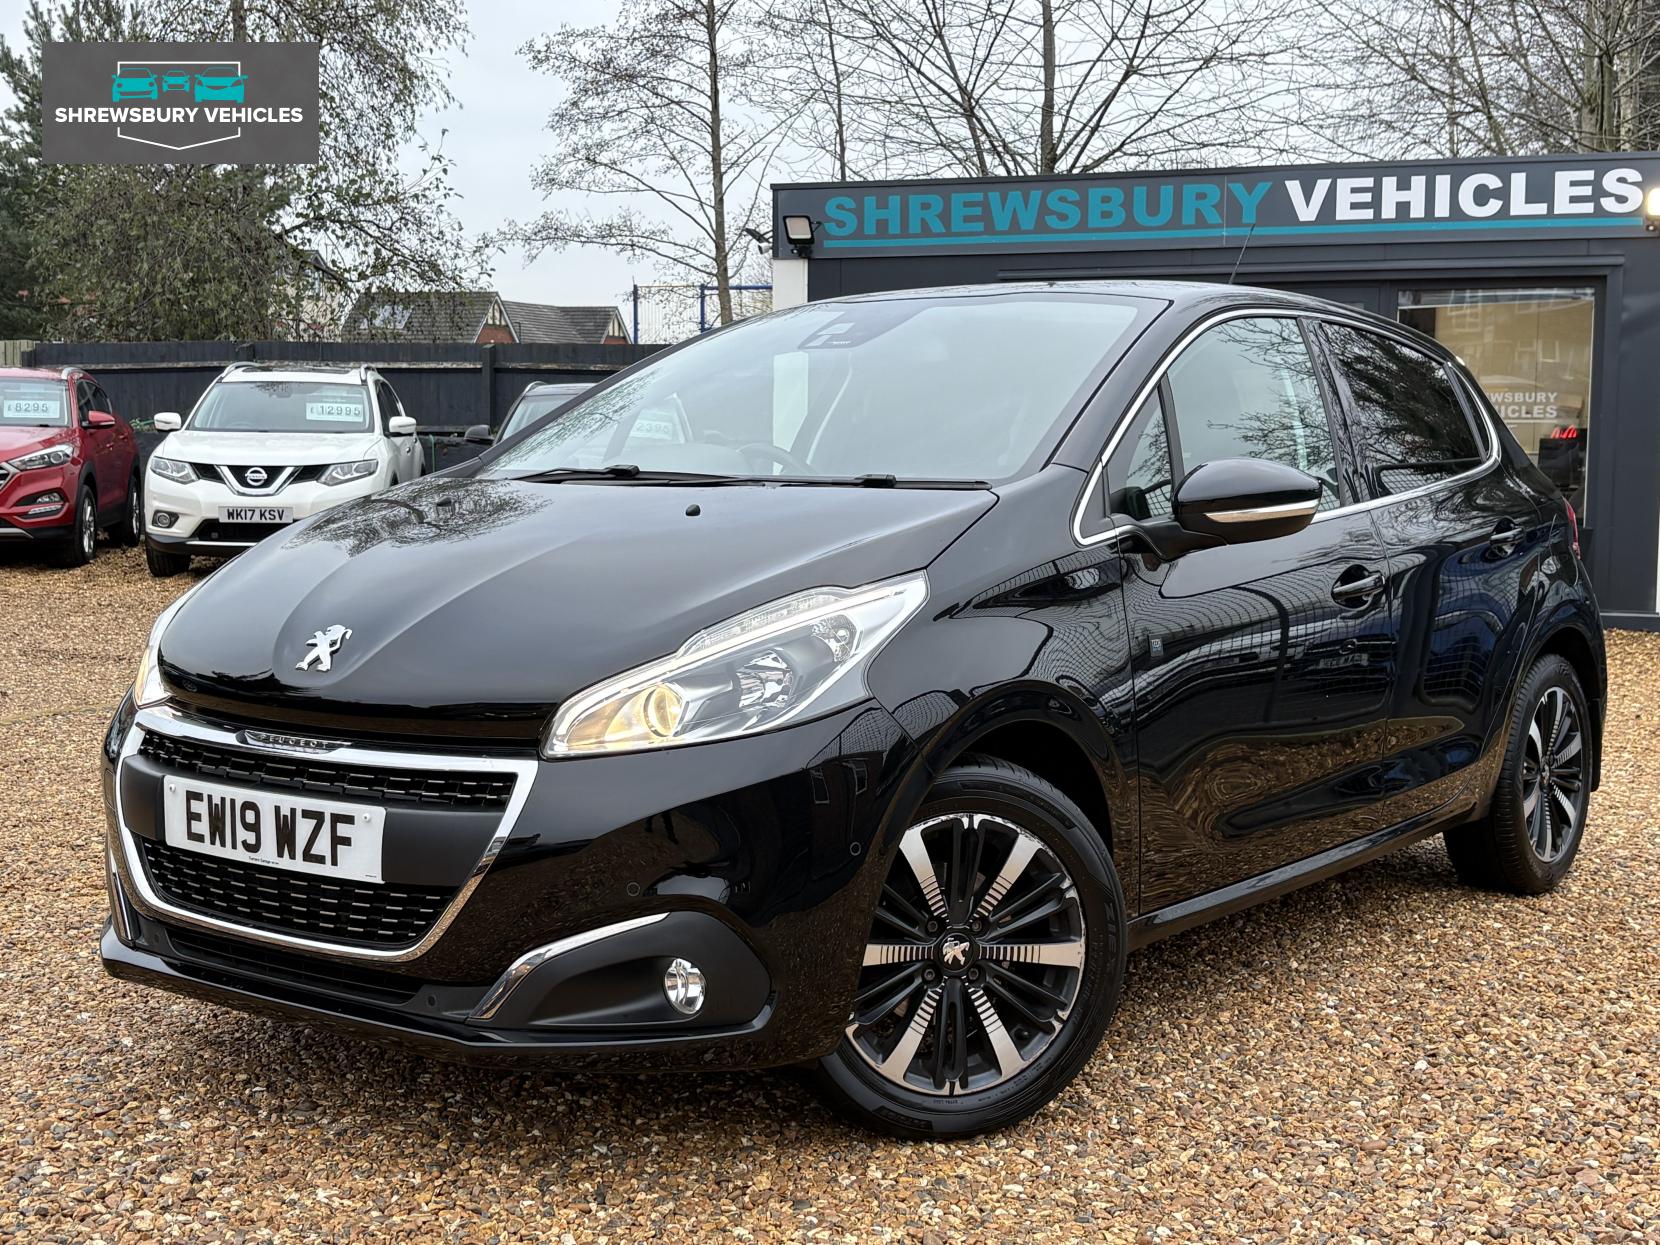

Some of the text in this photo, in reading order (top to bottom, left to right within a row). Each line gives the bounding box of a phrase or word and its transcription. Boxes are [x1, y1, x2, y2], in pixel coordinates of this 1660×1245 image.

[823, 168, 1644, 237] SHREWSBURY VEHICLES
[1486, 391, 1558, 403] WSBURY
[227, 508, 284, 521] WK17 KSV
[259, 733, 329, 749] PEUGEOT
[185, 790, 356, 867] EW19 WZF
